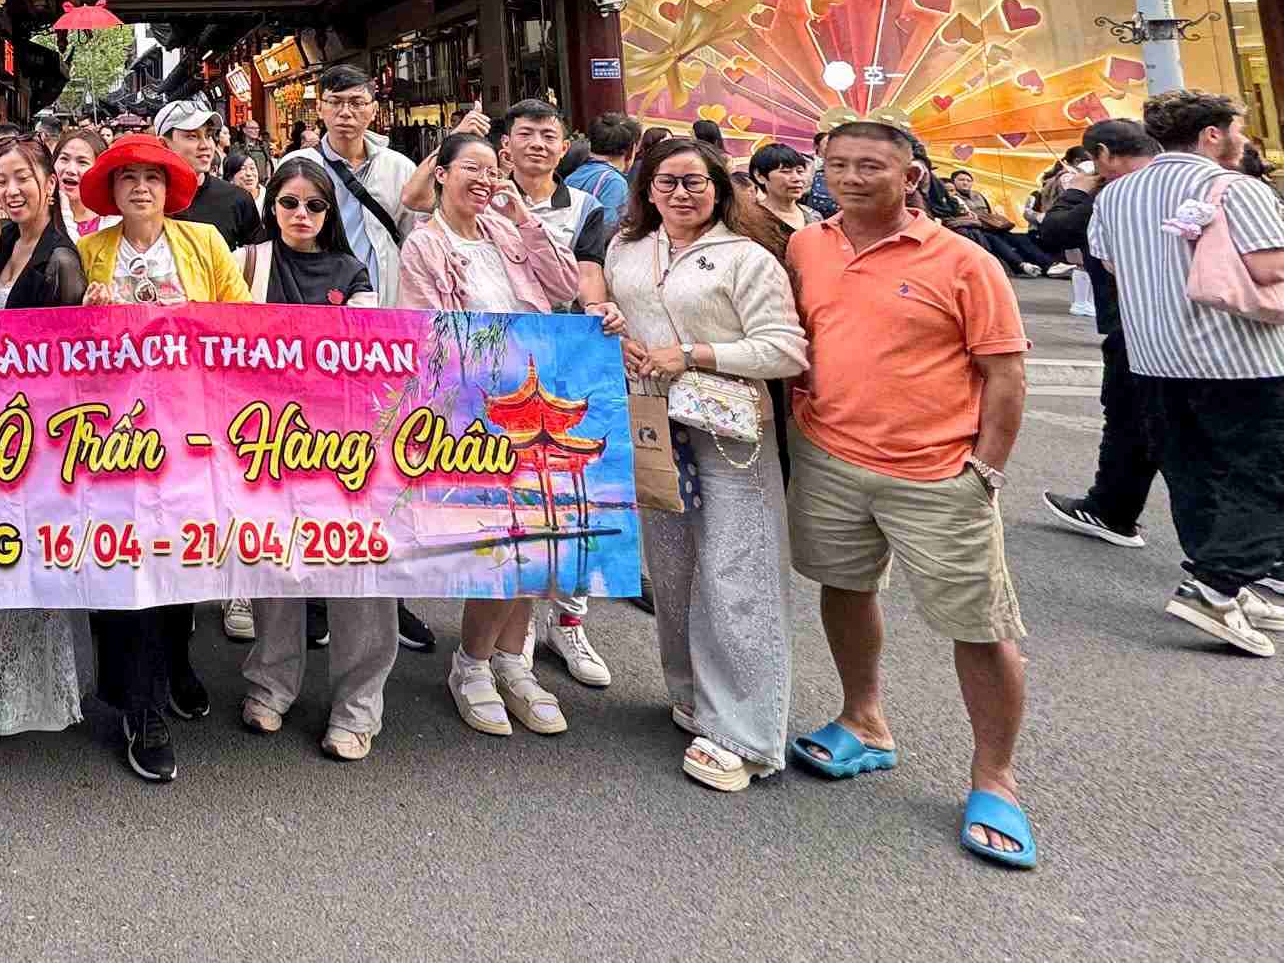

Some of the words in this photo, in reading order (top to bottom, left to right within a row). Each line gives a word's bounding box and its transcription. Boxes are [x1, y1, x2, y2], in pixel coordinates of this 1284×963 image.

[61, 333, 188, 371] KHÁCH
[199, 336, 304, 370] THAM
[316, 339, 416, 374] QUAN
[47, 399, 166, 485] Trấn
[186, 434, 213, 448] -
[228, 401, 375, 492] Hàng
[391, 407, 517, 478] Châu
[37, 517, 143, 571] 16/04
[152, 538, 172, 553] -
[180, 517, 391, 571] 21/04/2026
